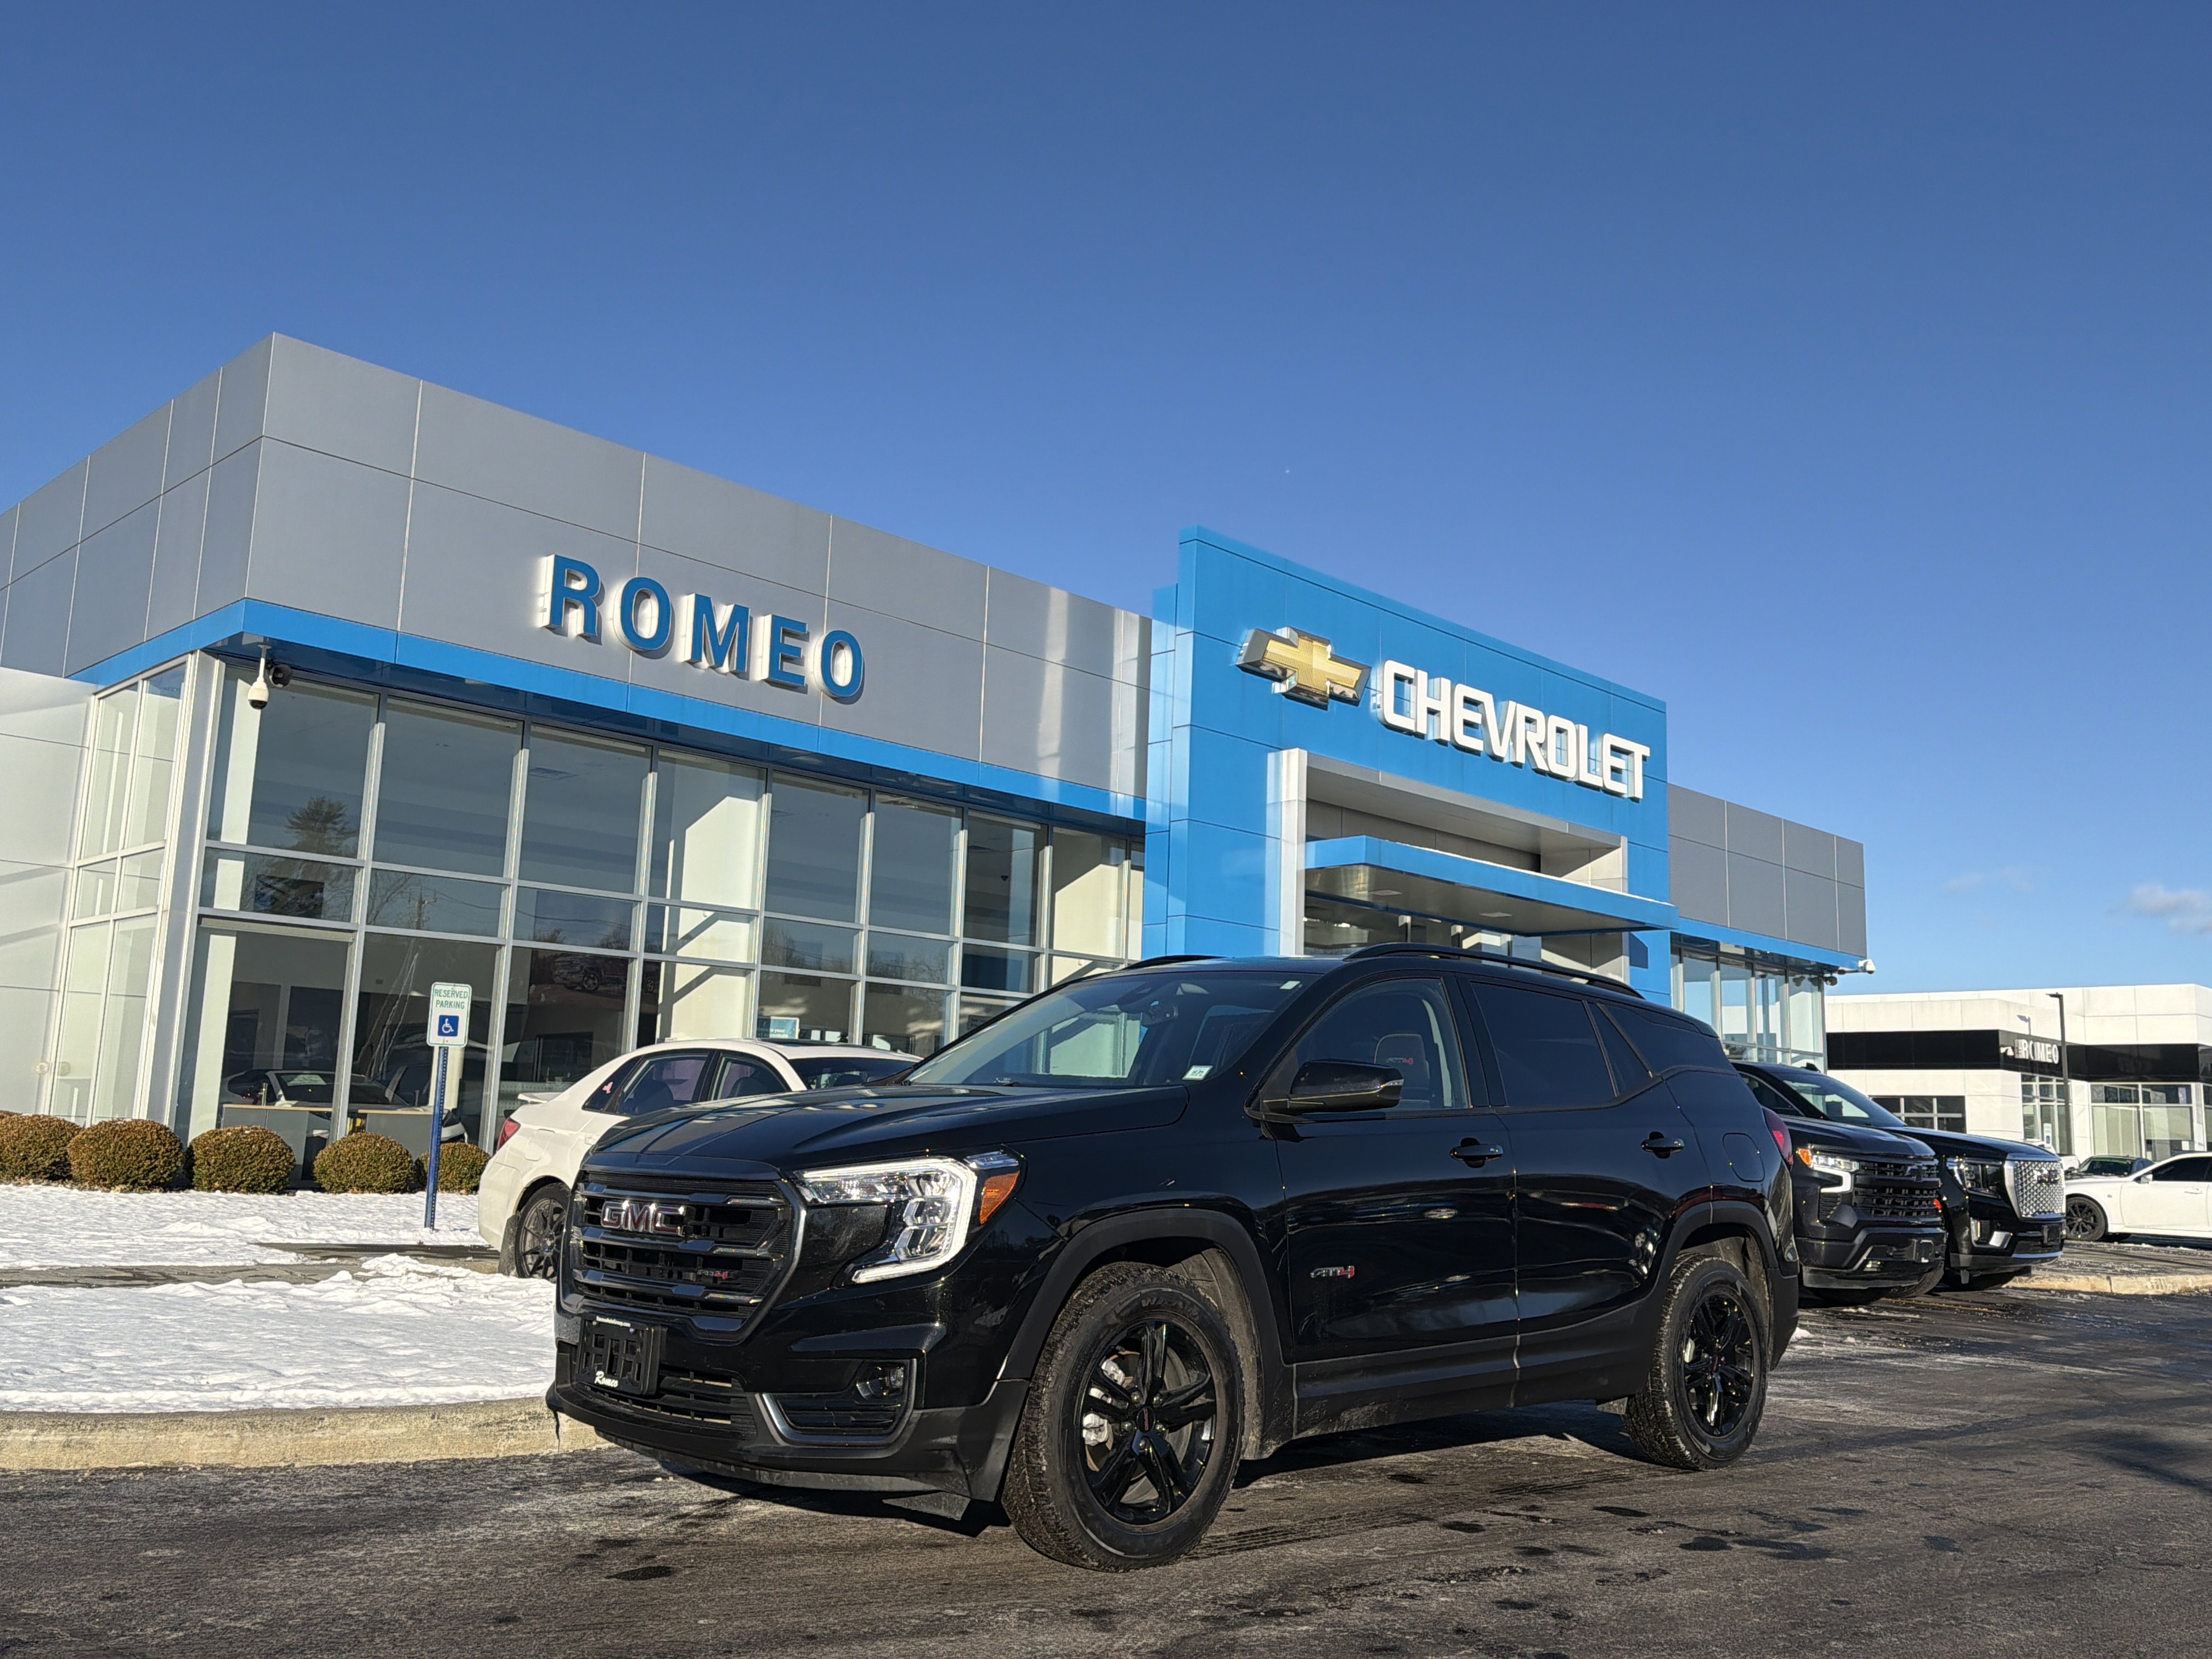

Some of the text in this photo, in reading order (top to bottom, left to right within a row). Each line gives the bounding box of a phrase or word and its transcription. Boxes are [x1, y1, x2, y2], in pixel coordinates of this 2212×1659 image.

[546, 554, 865, 698] ROMEO
[1379, 659, 1650, 800] CHEVROLET
[435, 989, 468, 999] RESERVED
[436, 1000, 465, 1009] PARKING
[2017, 1039, 2059, 1064] ROMEO
[601, 1200, 685, 1237] GMC
[594, 1370, 618, 1387] Romeo
